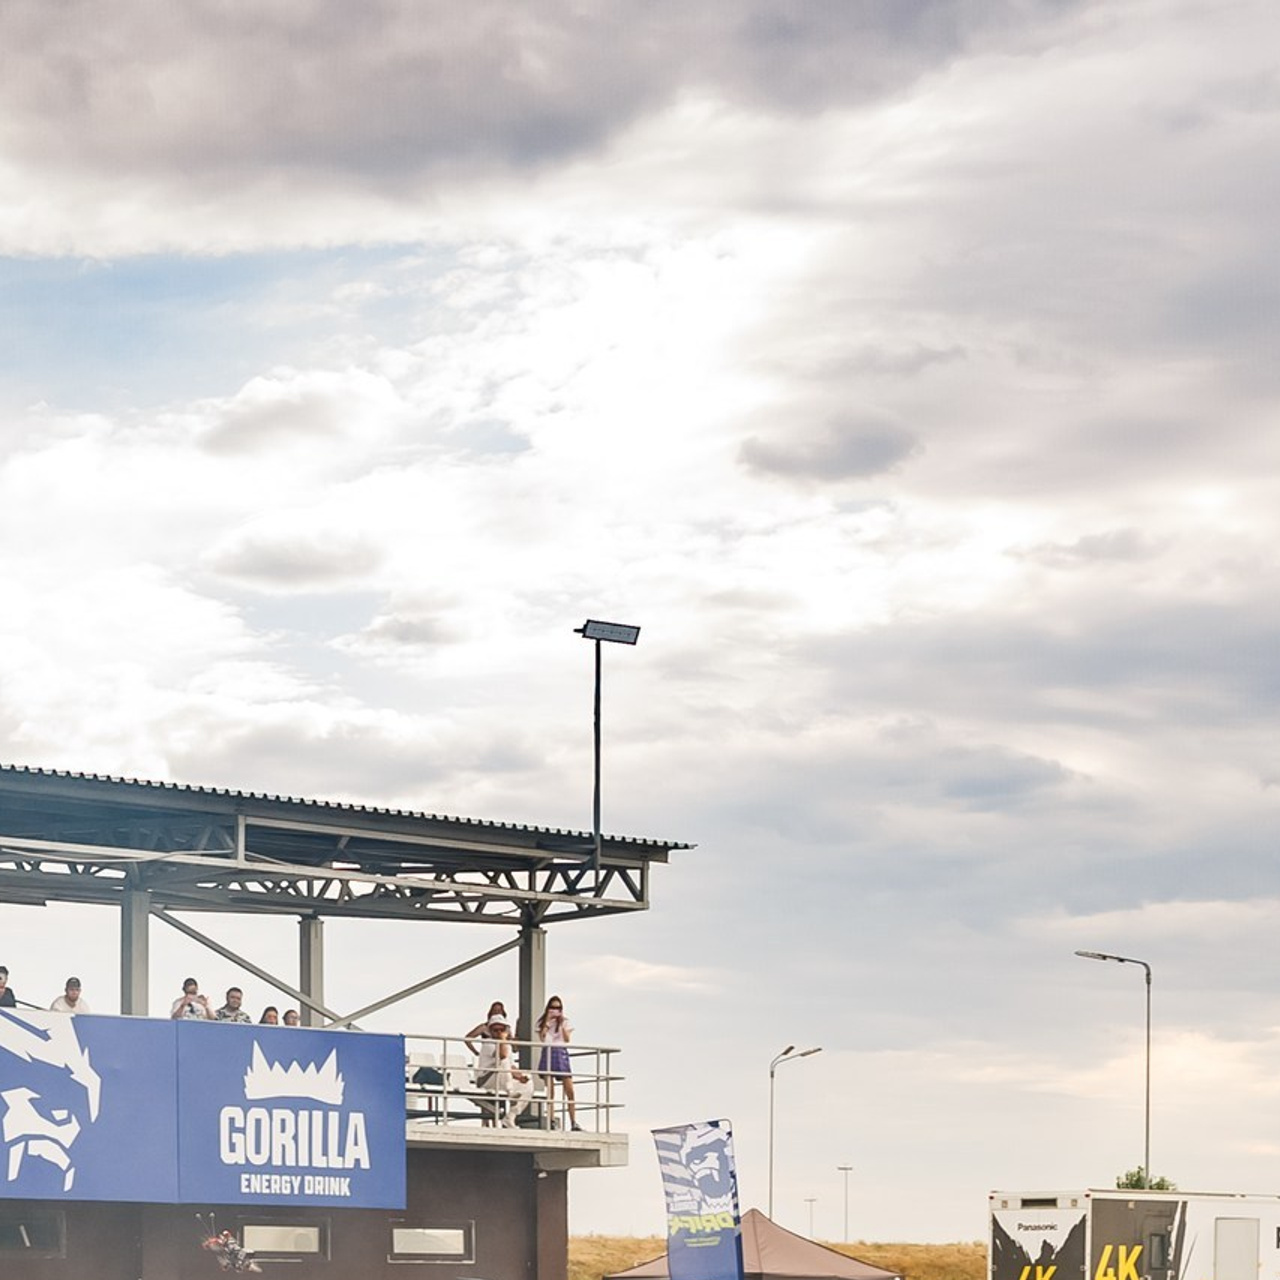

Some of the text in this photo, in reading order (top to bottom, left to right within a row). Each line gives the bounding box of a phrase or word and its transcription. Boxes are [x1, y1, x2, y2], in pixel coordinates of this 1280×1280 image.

[219, 1105, 371, 1170] GORILLA
[240, 1173, 351, 1197] ENERGY DRINK
[1017, 1223, 1059, 1231] Panasonic
